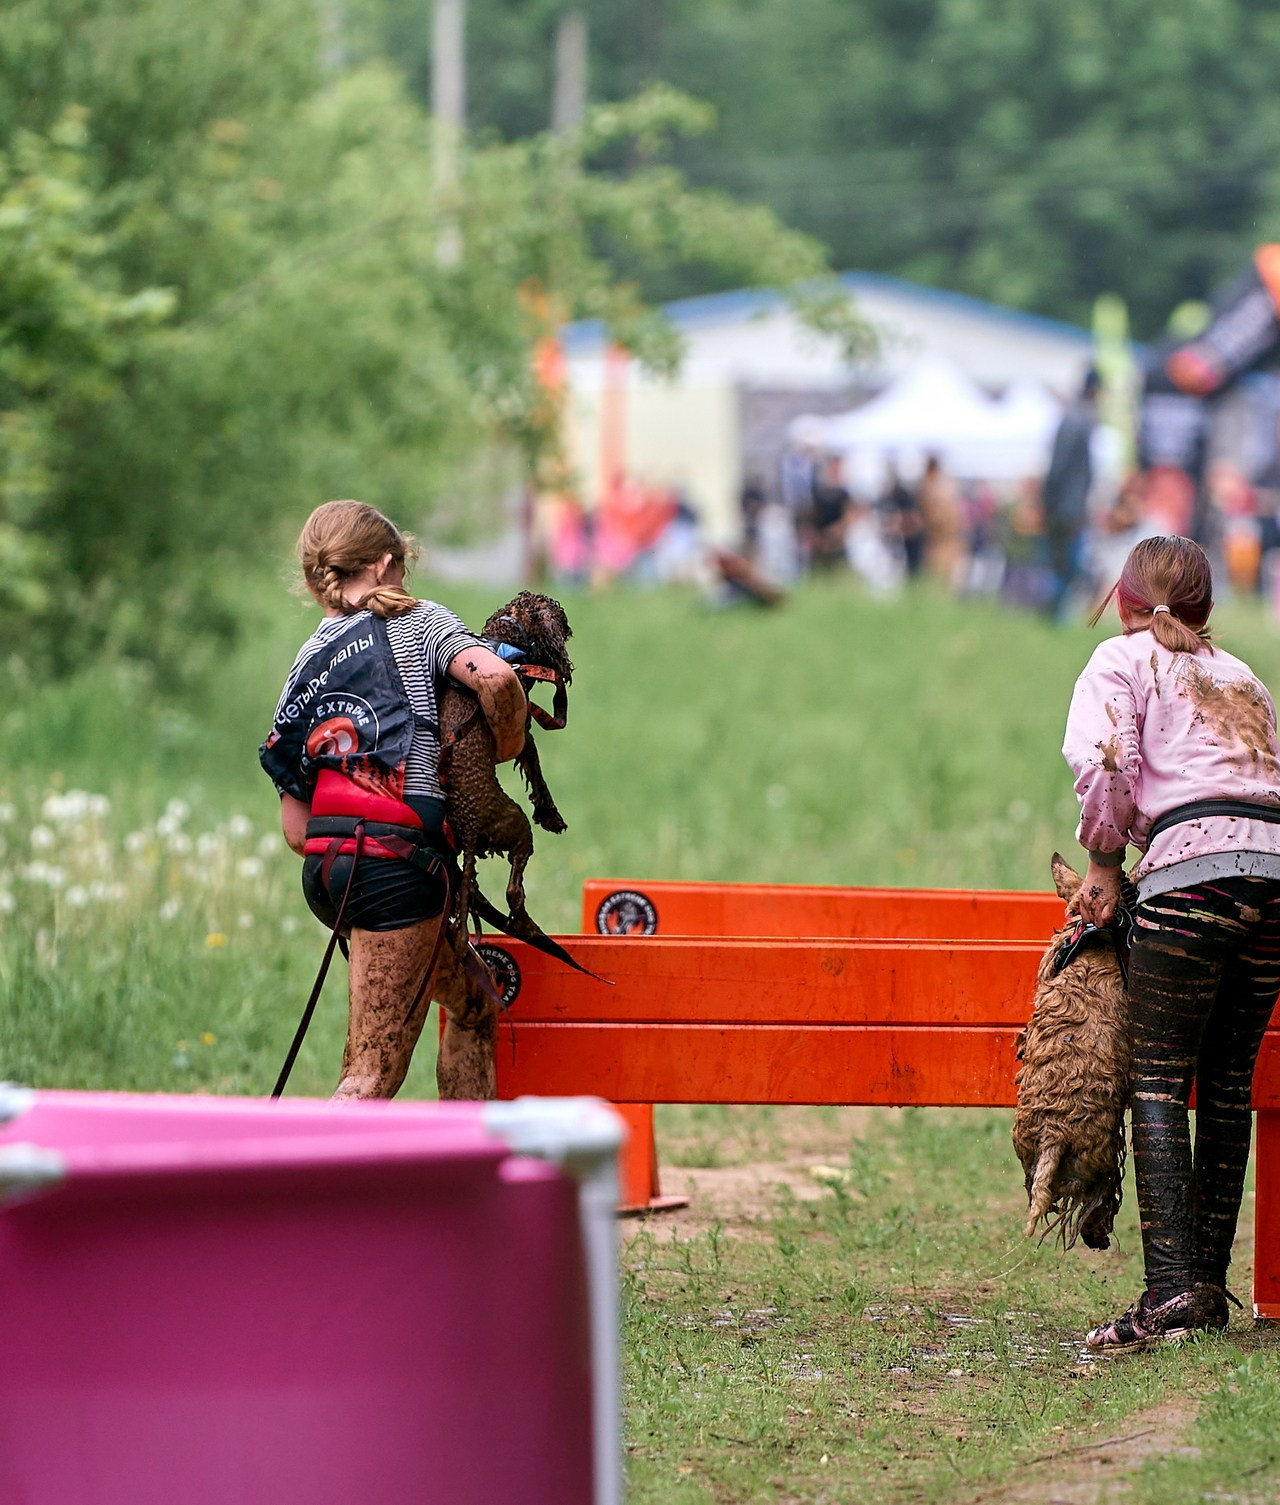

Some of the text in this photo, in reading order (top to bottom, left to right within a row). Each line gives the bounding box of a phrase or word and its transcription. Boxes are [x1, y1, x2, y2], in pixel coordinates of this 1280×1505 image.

[316, 701, 370, 726] EXTREME
[480, 949, 509, 964] TREME
[506, 963, 517, 983] DOG
